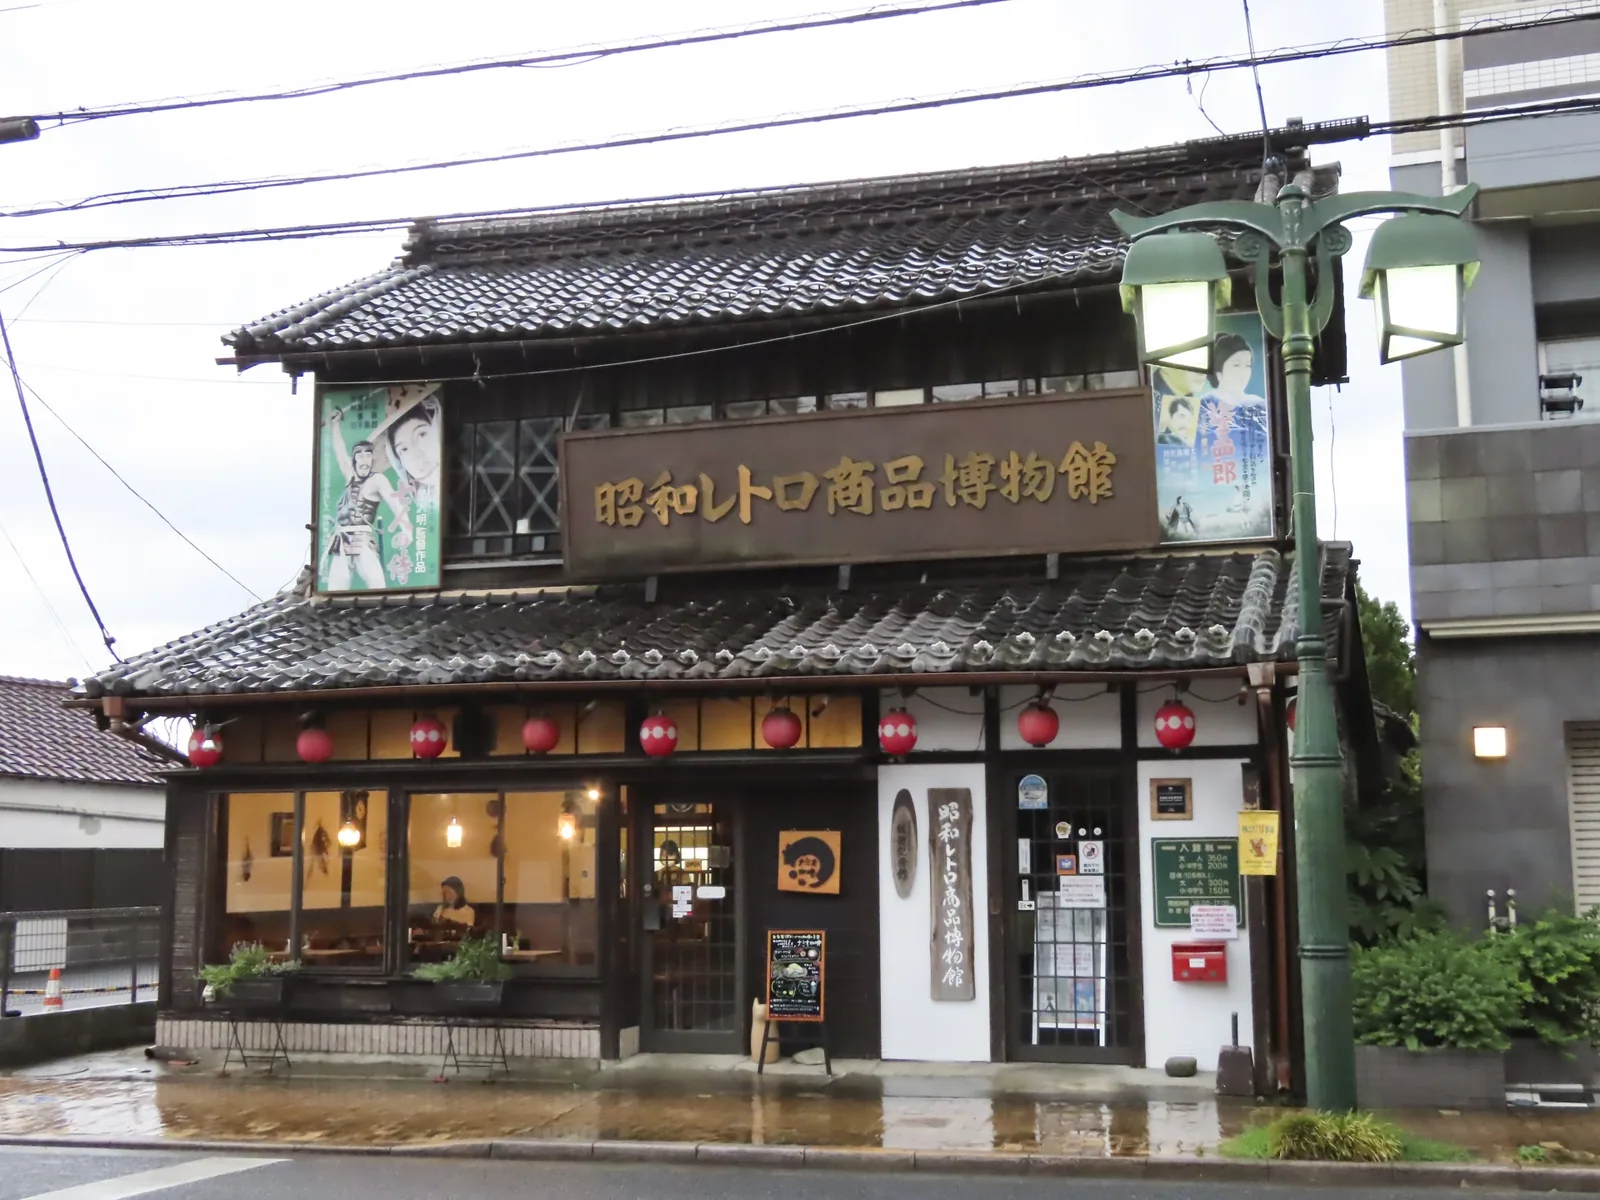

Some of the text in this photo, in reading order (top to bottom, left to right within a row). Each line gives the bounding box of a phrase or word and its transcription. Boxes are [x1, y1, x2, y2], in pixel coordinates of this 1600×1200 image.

[387, 480, 416, 585] 七人の侍
[594, 440, 1117, 528] 昭和レトロ商品博物館
[938, 801, 964, 987] 昭和レトロ商品博物館
